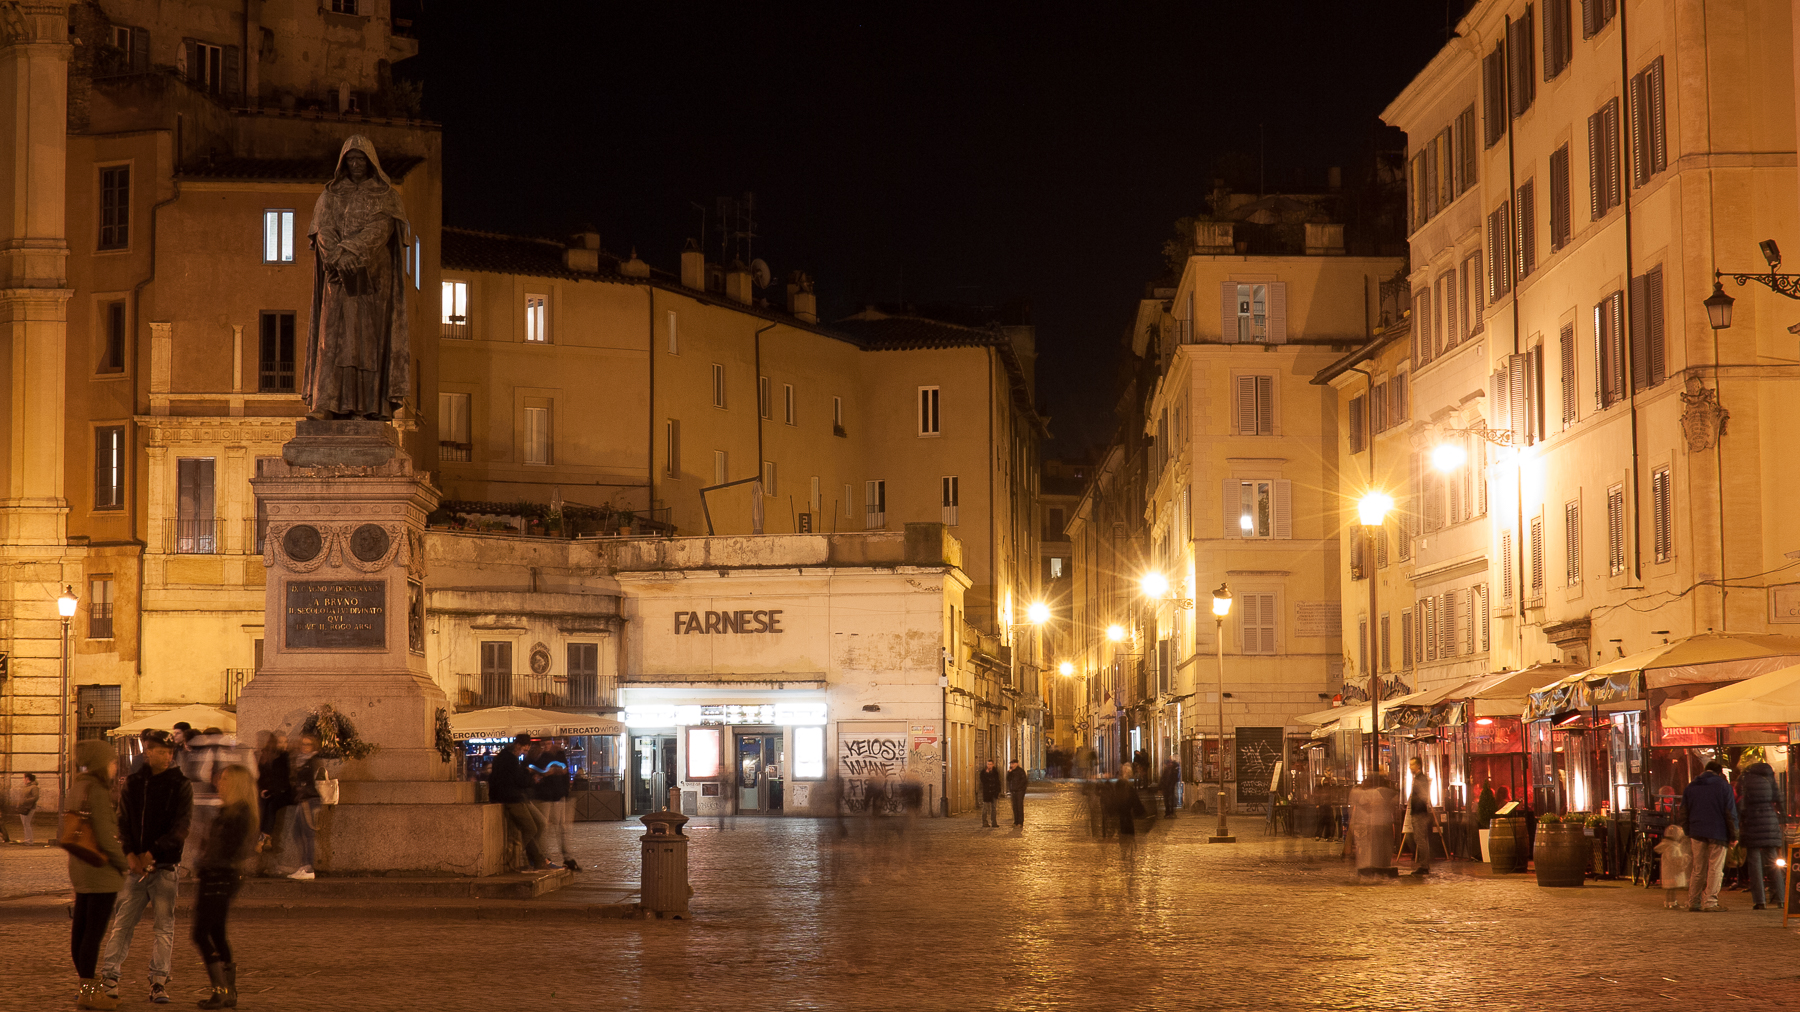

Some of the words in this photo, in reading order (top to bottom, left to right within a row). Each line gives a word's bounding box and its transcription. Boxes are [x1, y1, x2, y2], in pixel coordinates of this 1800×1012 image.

[313, 598, 320, 606] A
[324, 598, 359, 606] BRVNO
[327, 615, 344, 623] QVI
[674, 610, 783, 635] FARNESE
[452, 729, 506, 740] ERCATOwine
[525, 727, 541, 737] bar
